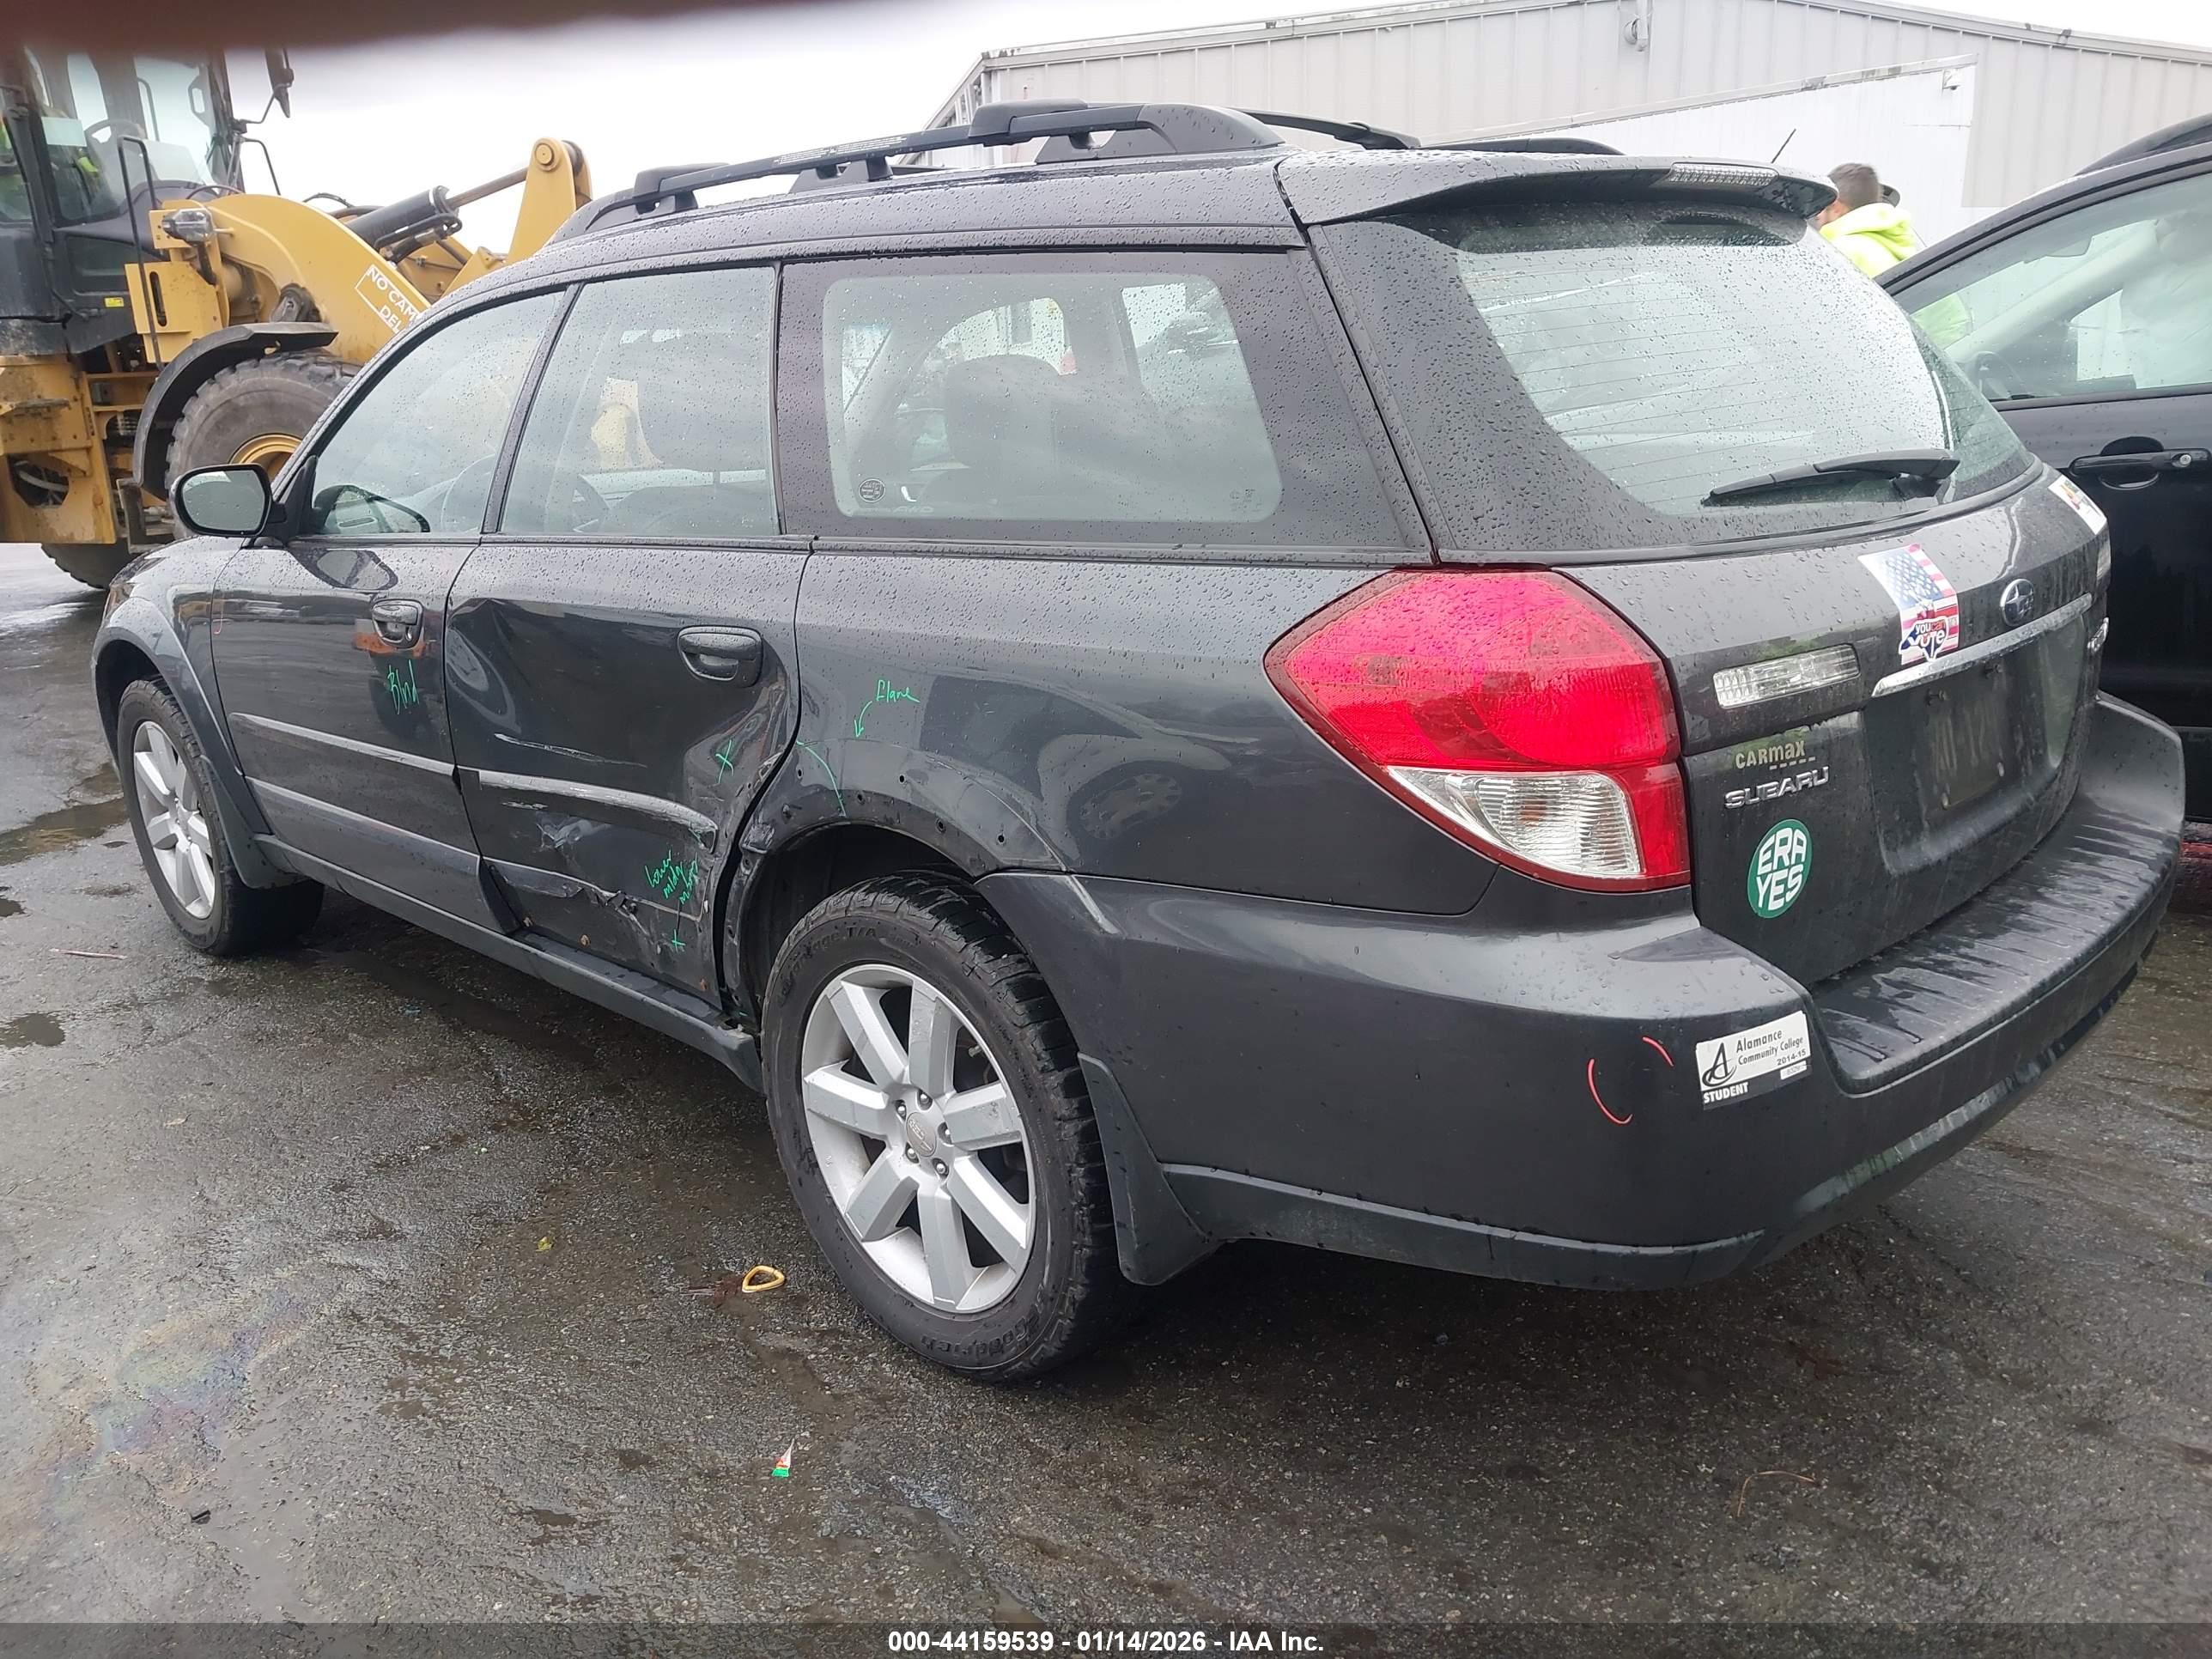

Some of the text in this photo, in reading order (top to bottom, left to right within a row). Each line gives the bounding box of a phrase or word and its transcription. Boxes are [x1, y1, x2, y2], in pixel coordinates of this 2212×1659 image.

[367, 267, 419, 322] NO CAM
[1724, 766, 1830, 809] SUBARU
[1757, 827, 1808, 875] ERA
[1756, 864, 1804, 911] YES
[1735, 1030, 1783, 1054] Alamance
[1738, 1036, 1804, 1066] Community College
[1777, 1048, 1807, 1066] 2014-15
[1703, 1082, 1749, 1103] STUDENT
